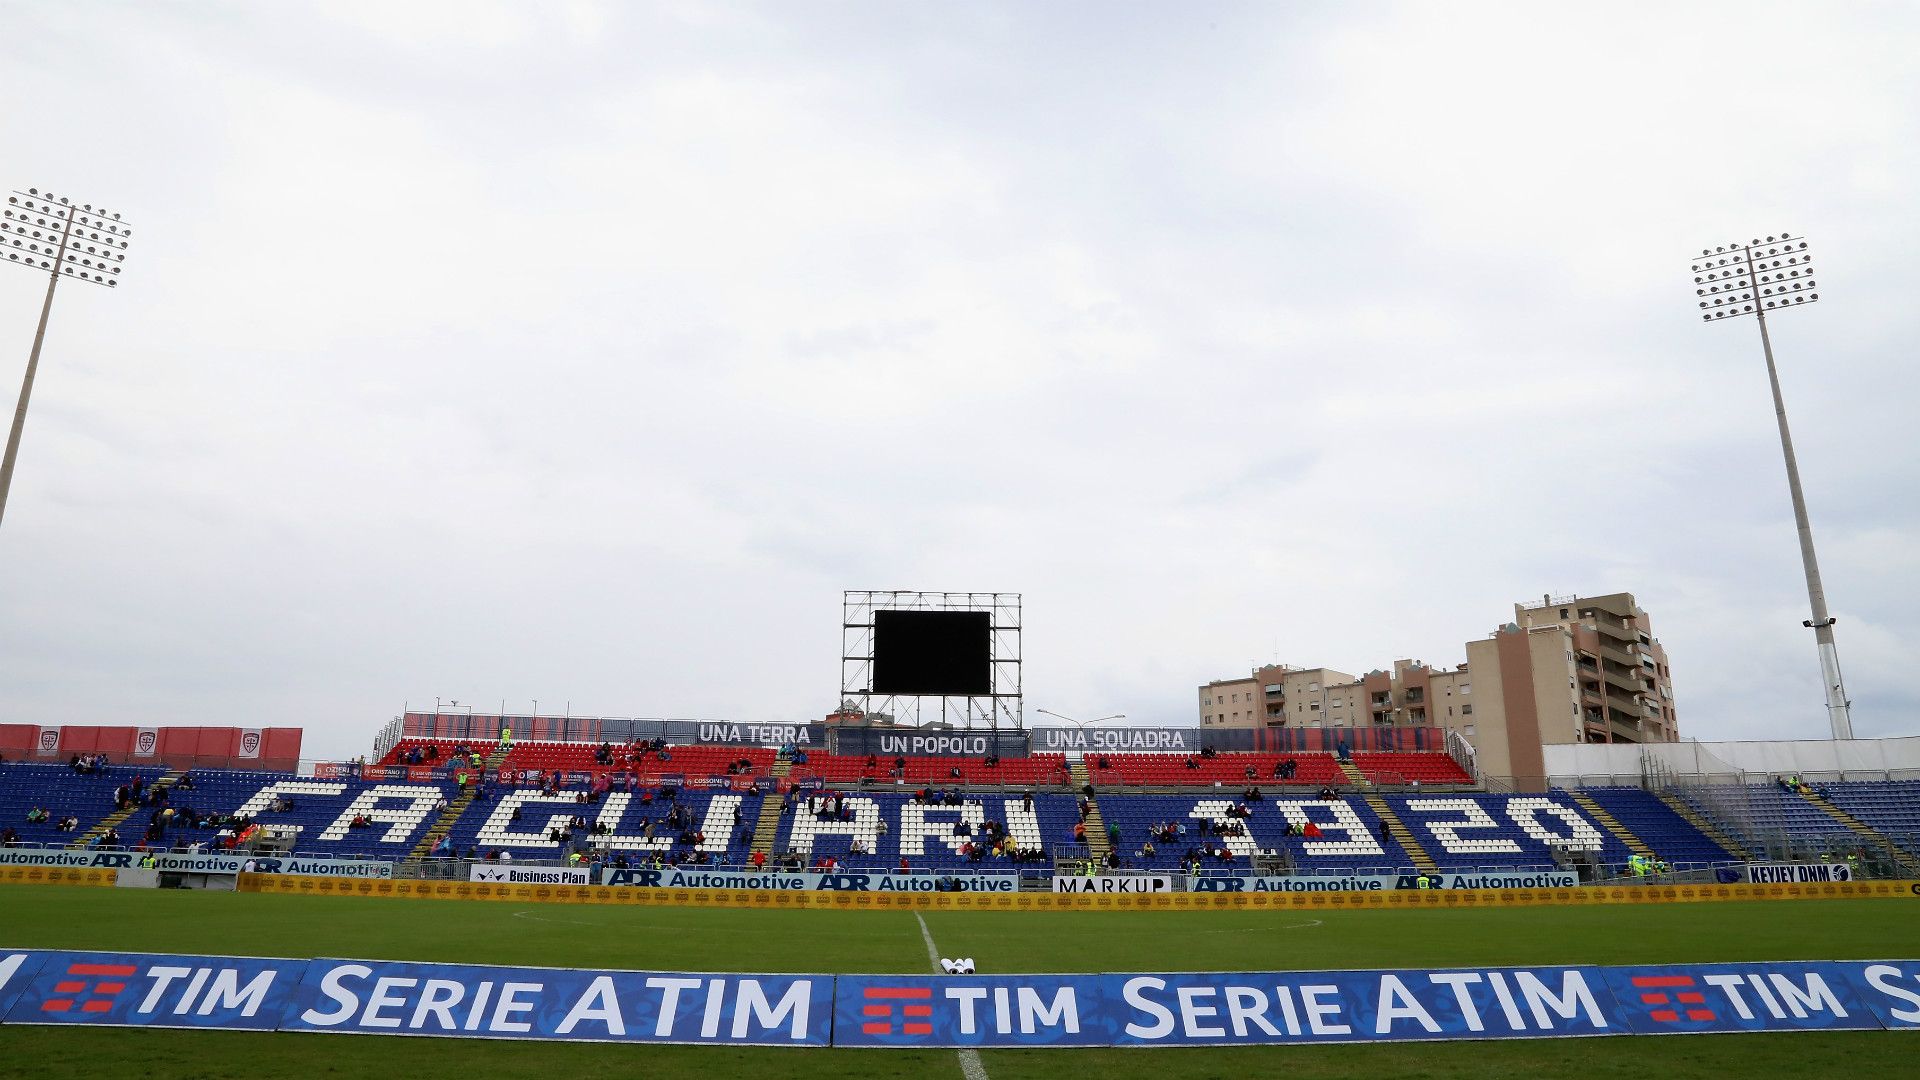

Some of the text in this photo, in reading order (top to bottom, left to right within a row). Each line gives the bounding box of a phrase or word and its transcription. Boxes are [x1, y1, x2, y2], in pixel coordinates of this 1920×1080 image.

[700, 724, 811, 744] UNA TERRA
[1046, 730, 1185, 750] UNA SQUADRA
[880, 735, 987, 754] UN POPOLO
[216, 781, 1604, 856] CAGLIARI 1920
[0, 850, 133, 868] utomotive ADR
[509, 870, 586, 884] Business Plan
[608, 869, 804, 889] ADR Automotive
[816, 875, 1013, 892] ADR Autootive
[1394, 873, 1574, 890] AR Automotive
[1750, 865, 1831, 883] KEYJEY DNM
[1059, 878, 1165, 893] MARKUP
[1194, 877, 1382, 892] ADR Automotive
[138, 966, 277, 1017] TIM
[1703, 973, 1849, 1019] TIM
[554, 976, 626, 1036] A
[644, 976, 812, 1038] TIM
[945, 986, 1080, 1034] TIM
[1375, 974, 1445, 1034] A
[1430, 970, 1608, 1031] TIM
